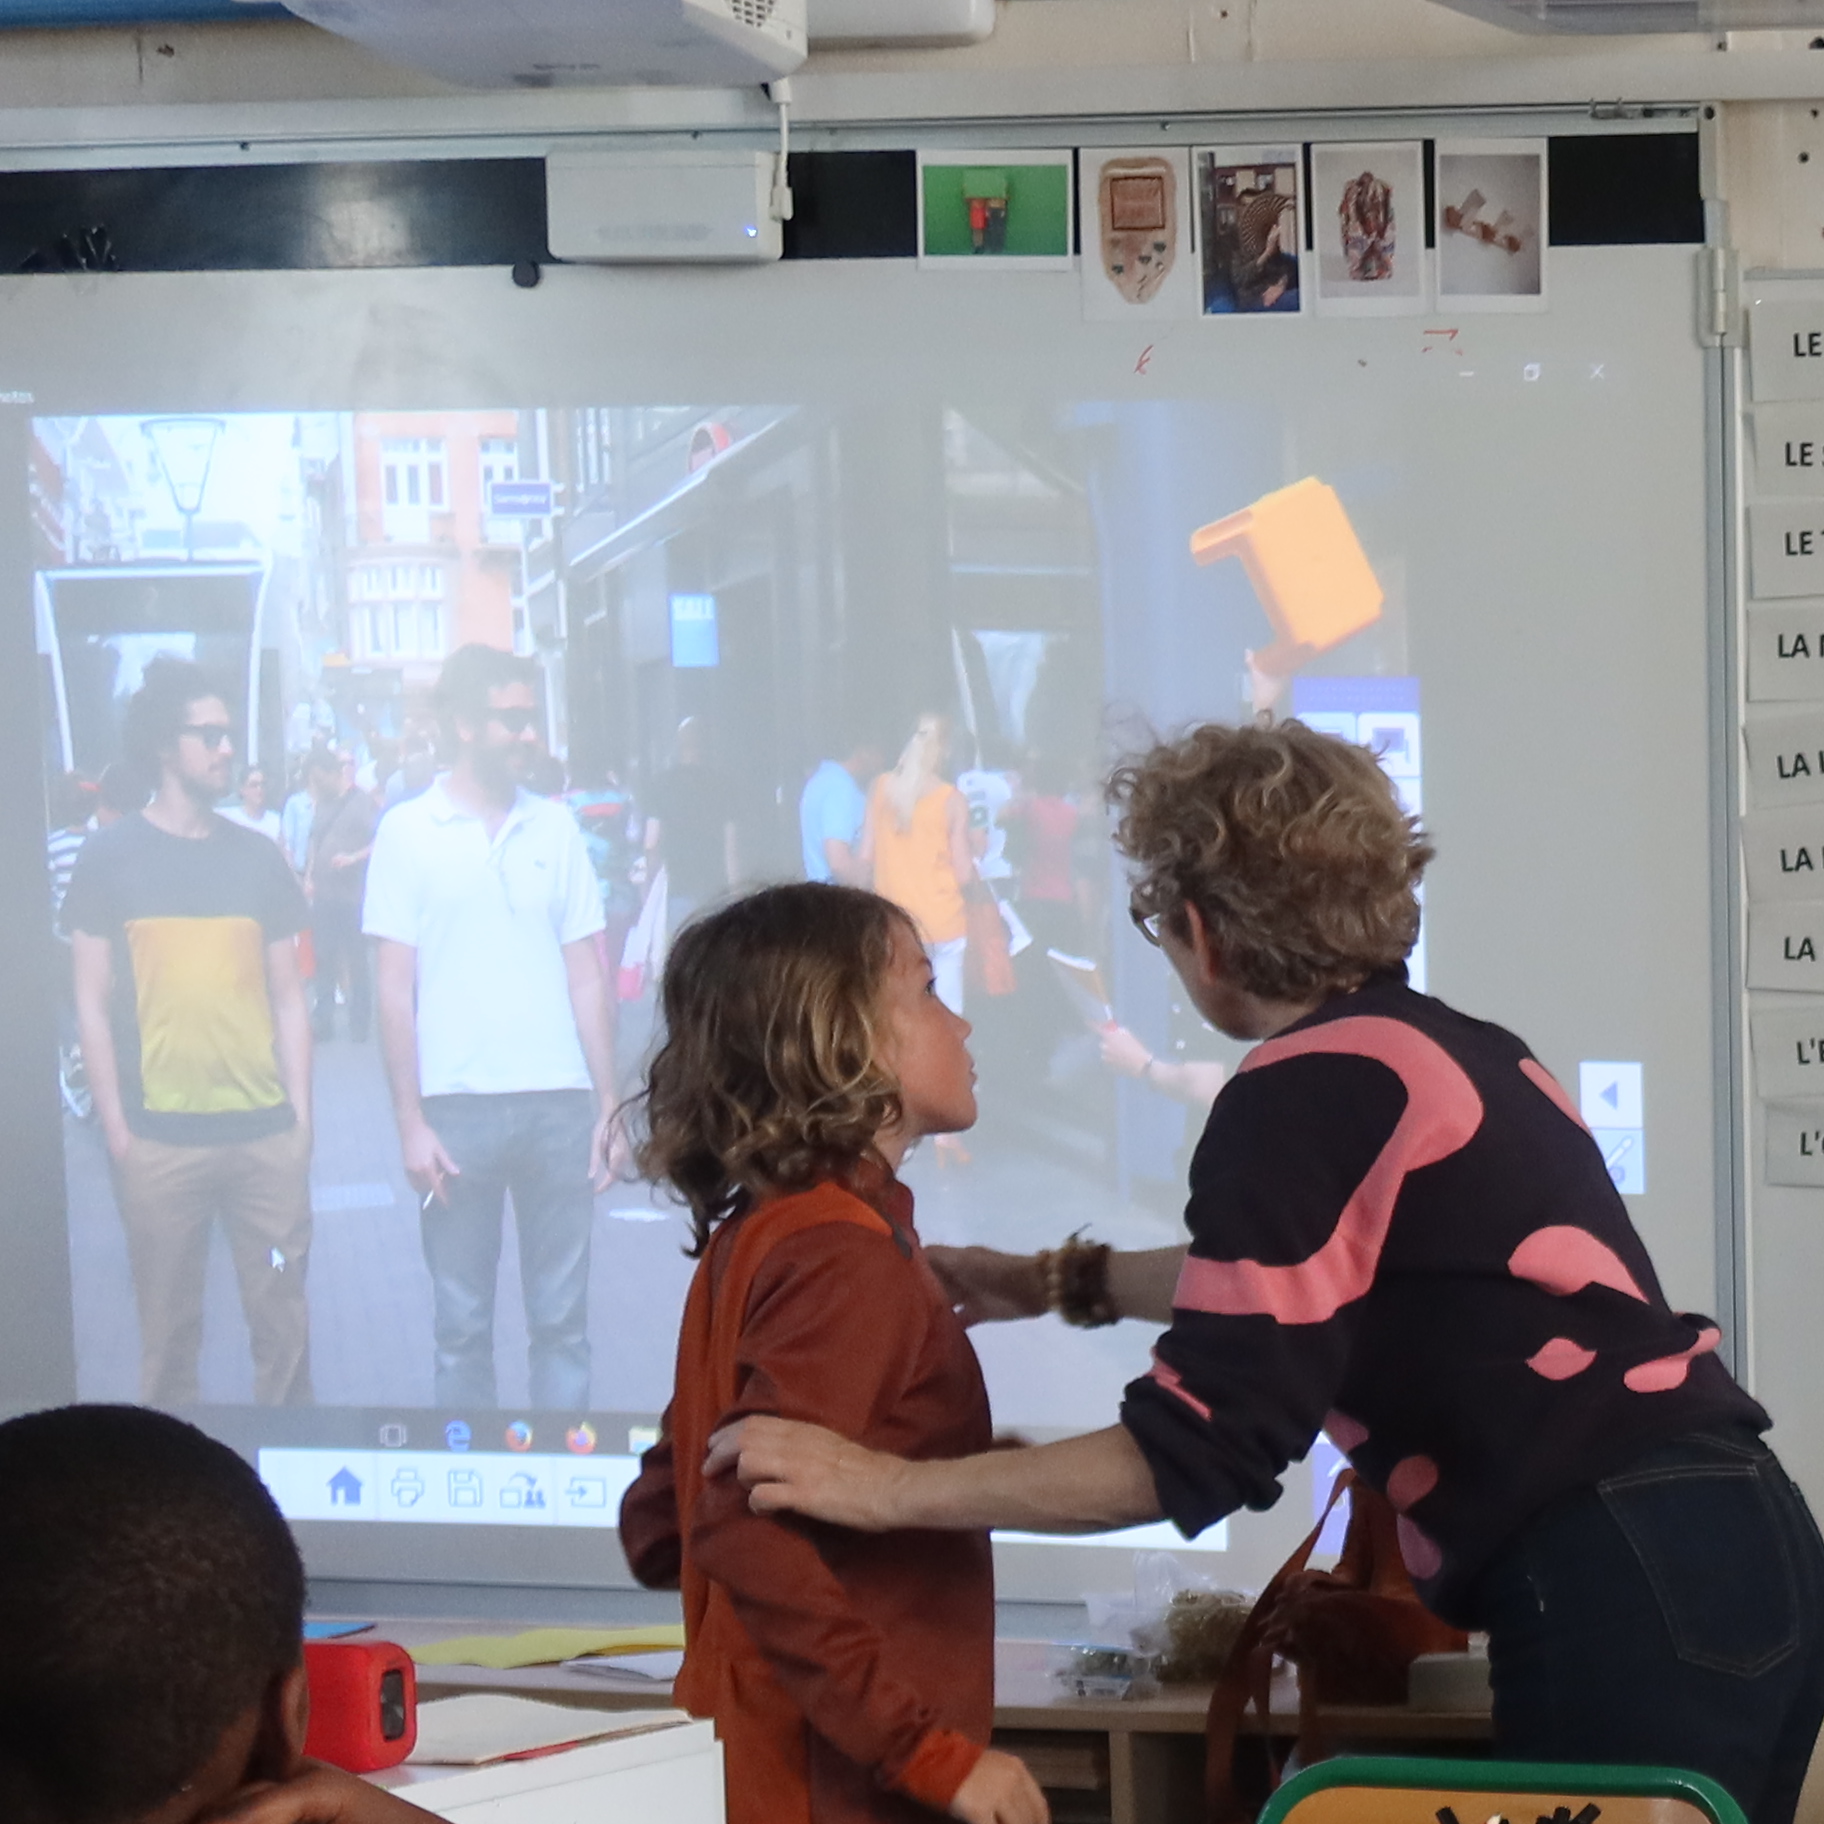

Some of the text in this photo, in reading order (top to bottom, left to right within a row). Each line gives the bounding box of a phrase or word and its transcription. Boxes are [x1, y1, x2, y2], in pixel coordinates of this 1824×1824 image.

[1793, 332, 1822, 357] LE
[1784, 442, 1814, 467] LE
[1784, 530, 1814, 555] LE
[1777, 633, 1810, 658] LA
[1777, 753, 1811, 779] LA
[1780, 847, 1814, 872] LA
[1784, 936, 1816, 961] LA
